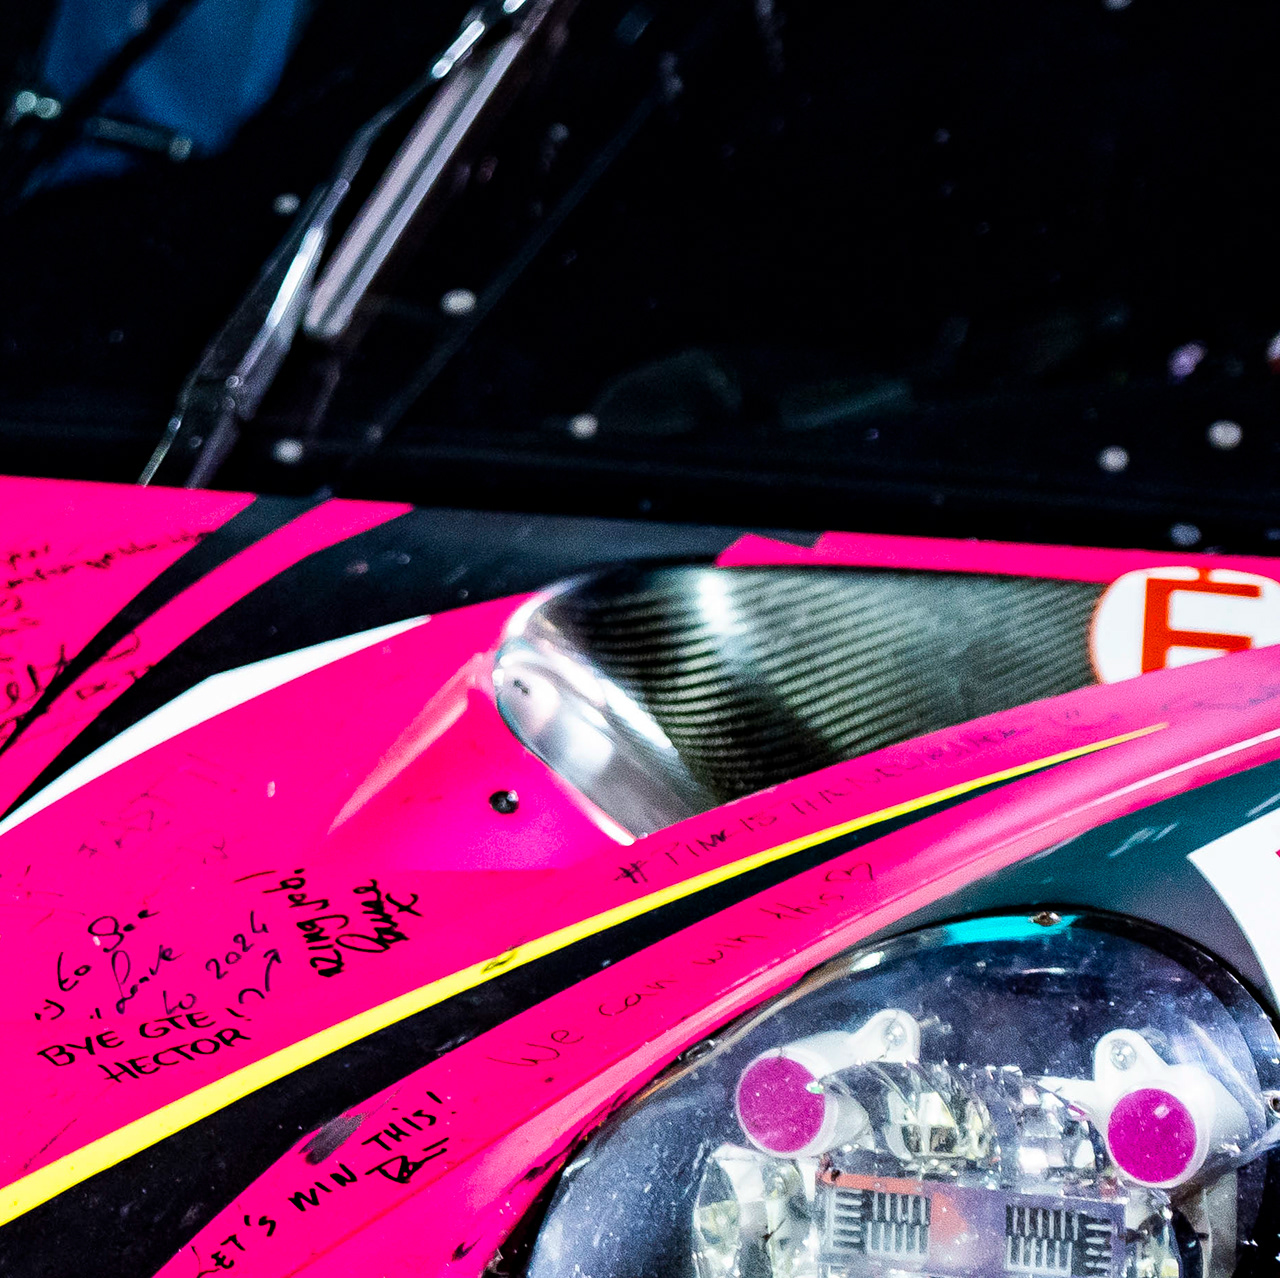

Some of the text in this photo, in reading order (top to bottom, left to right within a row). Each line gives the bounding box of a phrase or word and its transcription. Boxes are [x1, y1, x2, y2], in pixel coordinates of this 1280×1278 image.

[598, 979, 678, 1017] can
[37, 1031, 124, 1067] BYE
[98, 1027, 251, 1083] HECTOR
[287, 1163, 358, 1212] WIN
